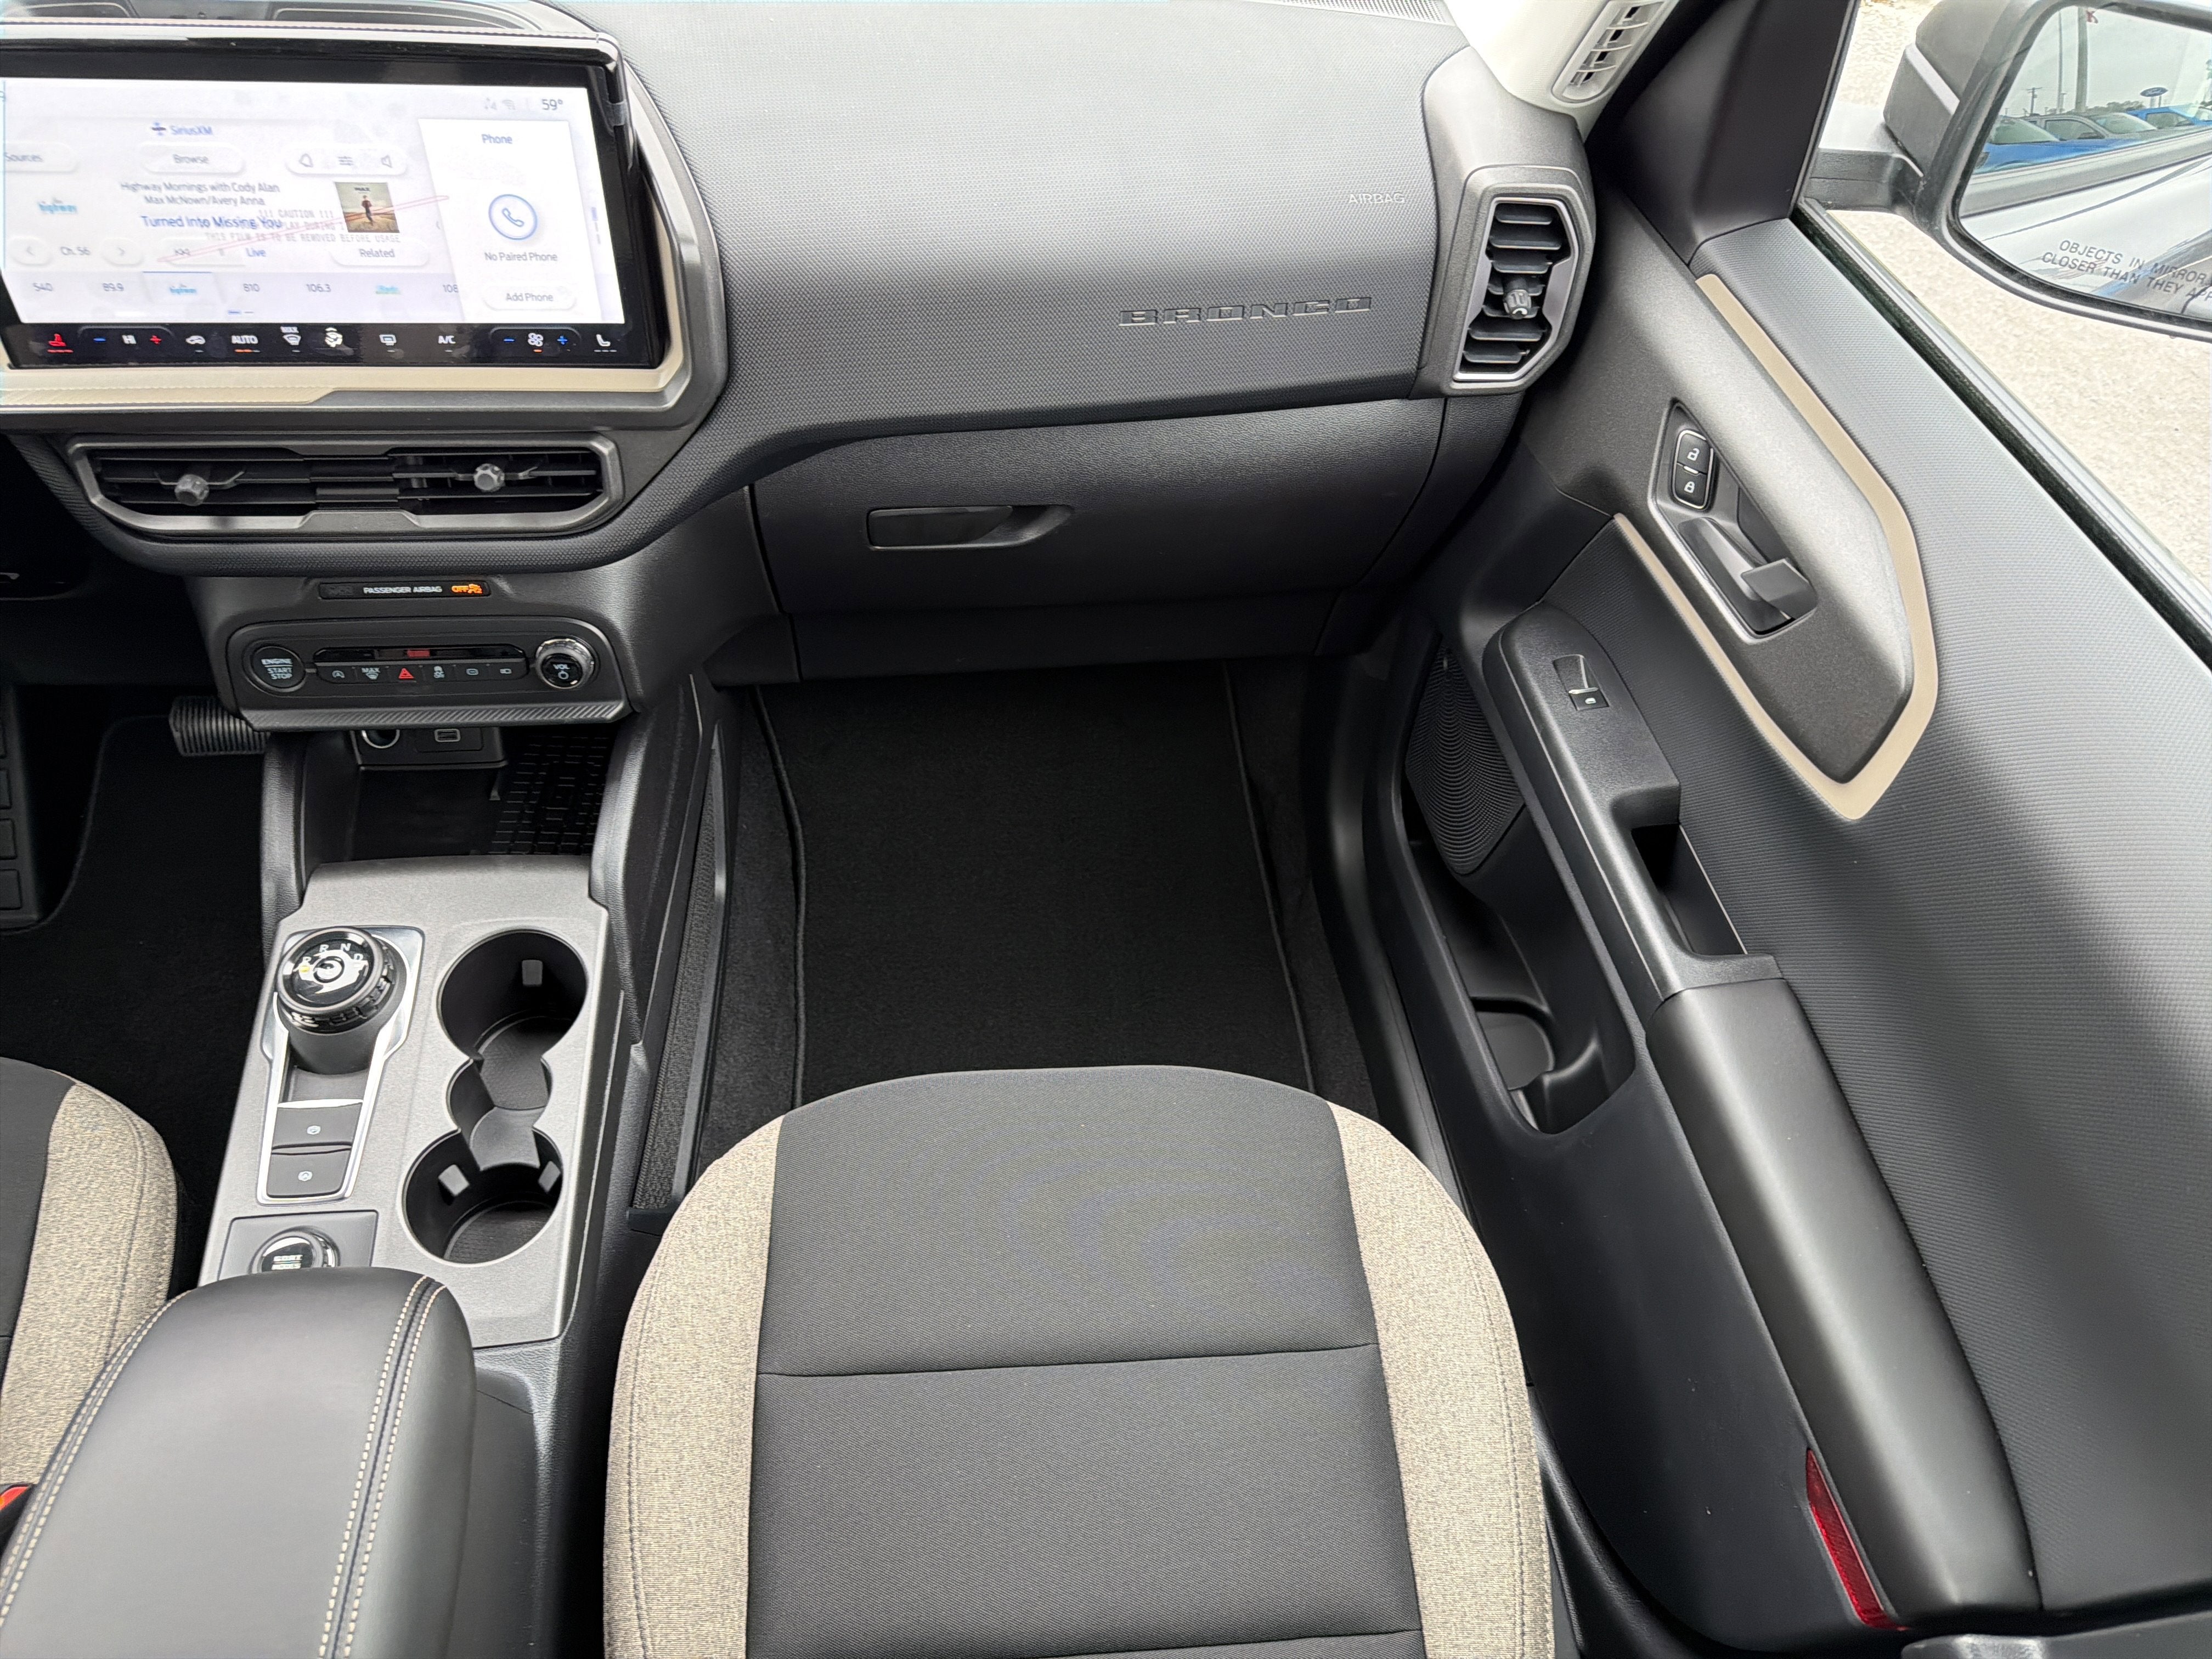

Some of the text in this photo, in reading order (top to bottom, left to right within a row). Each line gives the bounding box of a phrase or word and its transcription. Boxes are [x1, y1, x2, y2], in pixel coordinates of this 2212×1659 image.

[541, 98, 563, 111] 59°
[170, 125, 213, 136] SiriusXM
[481, 133, 513, 144] Phone
[172, 154, 210, 164] Browse
[120, 181, 281, 194] Highway Mornings with Cody Alan
[144, 195, 266, 207] Max McNown/Avery Anna
[1348, 193, 1406, 204] AIRBAG
[278, 209, 314, 218] CAUTION
[140, 215, 283, 230] Turned Into Missing You
[301, 234, 336, 242] REMOVED
[340, 233, 371, 243] BEFORE
[375, 234, 402, 243] USAGE
[245, 247, 267, 257] Live
[359, 248, 396, 258] Related
[484, 251, 558, 262] No Paired Phone
[2059, 240, 2207, 284] OBJECTS IN MIRROR
[2042, 252, 2097, 273] CLOSER
[2103, 266, 2141, 284] THAN
[2146, 276, 2185, 294] THEY
[506, 292, 554, 302] Add Phone
[1119, 296, 1372, 326] BRONCO
[232, 335, 258, 344] AUTO
[438, 335, 456, 345] A/C
[319, 944, 329, 952] R
[340, 943, 352, 951] N
